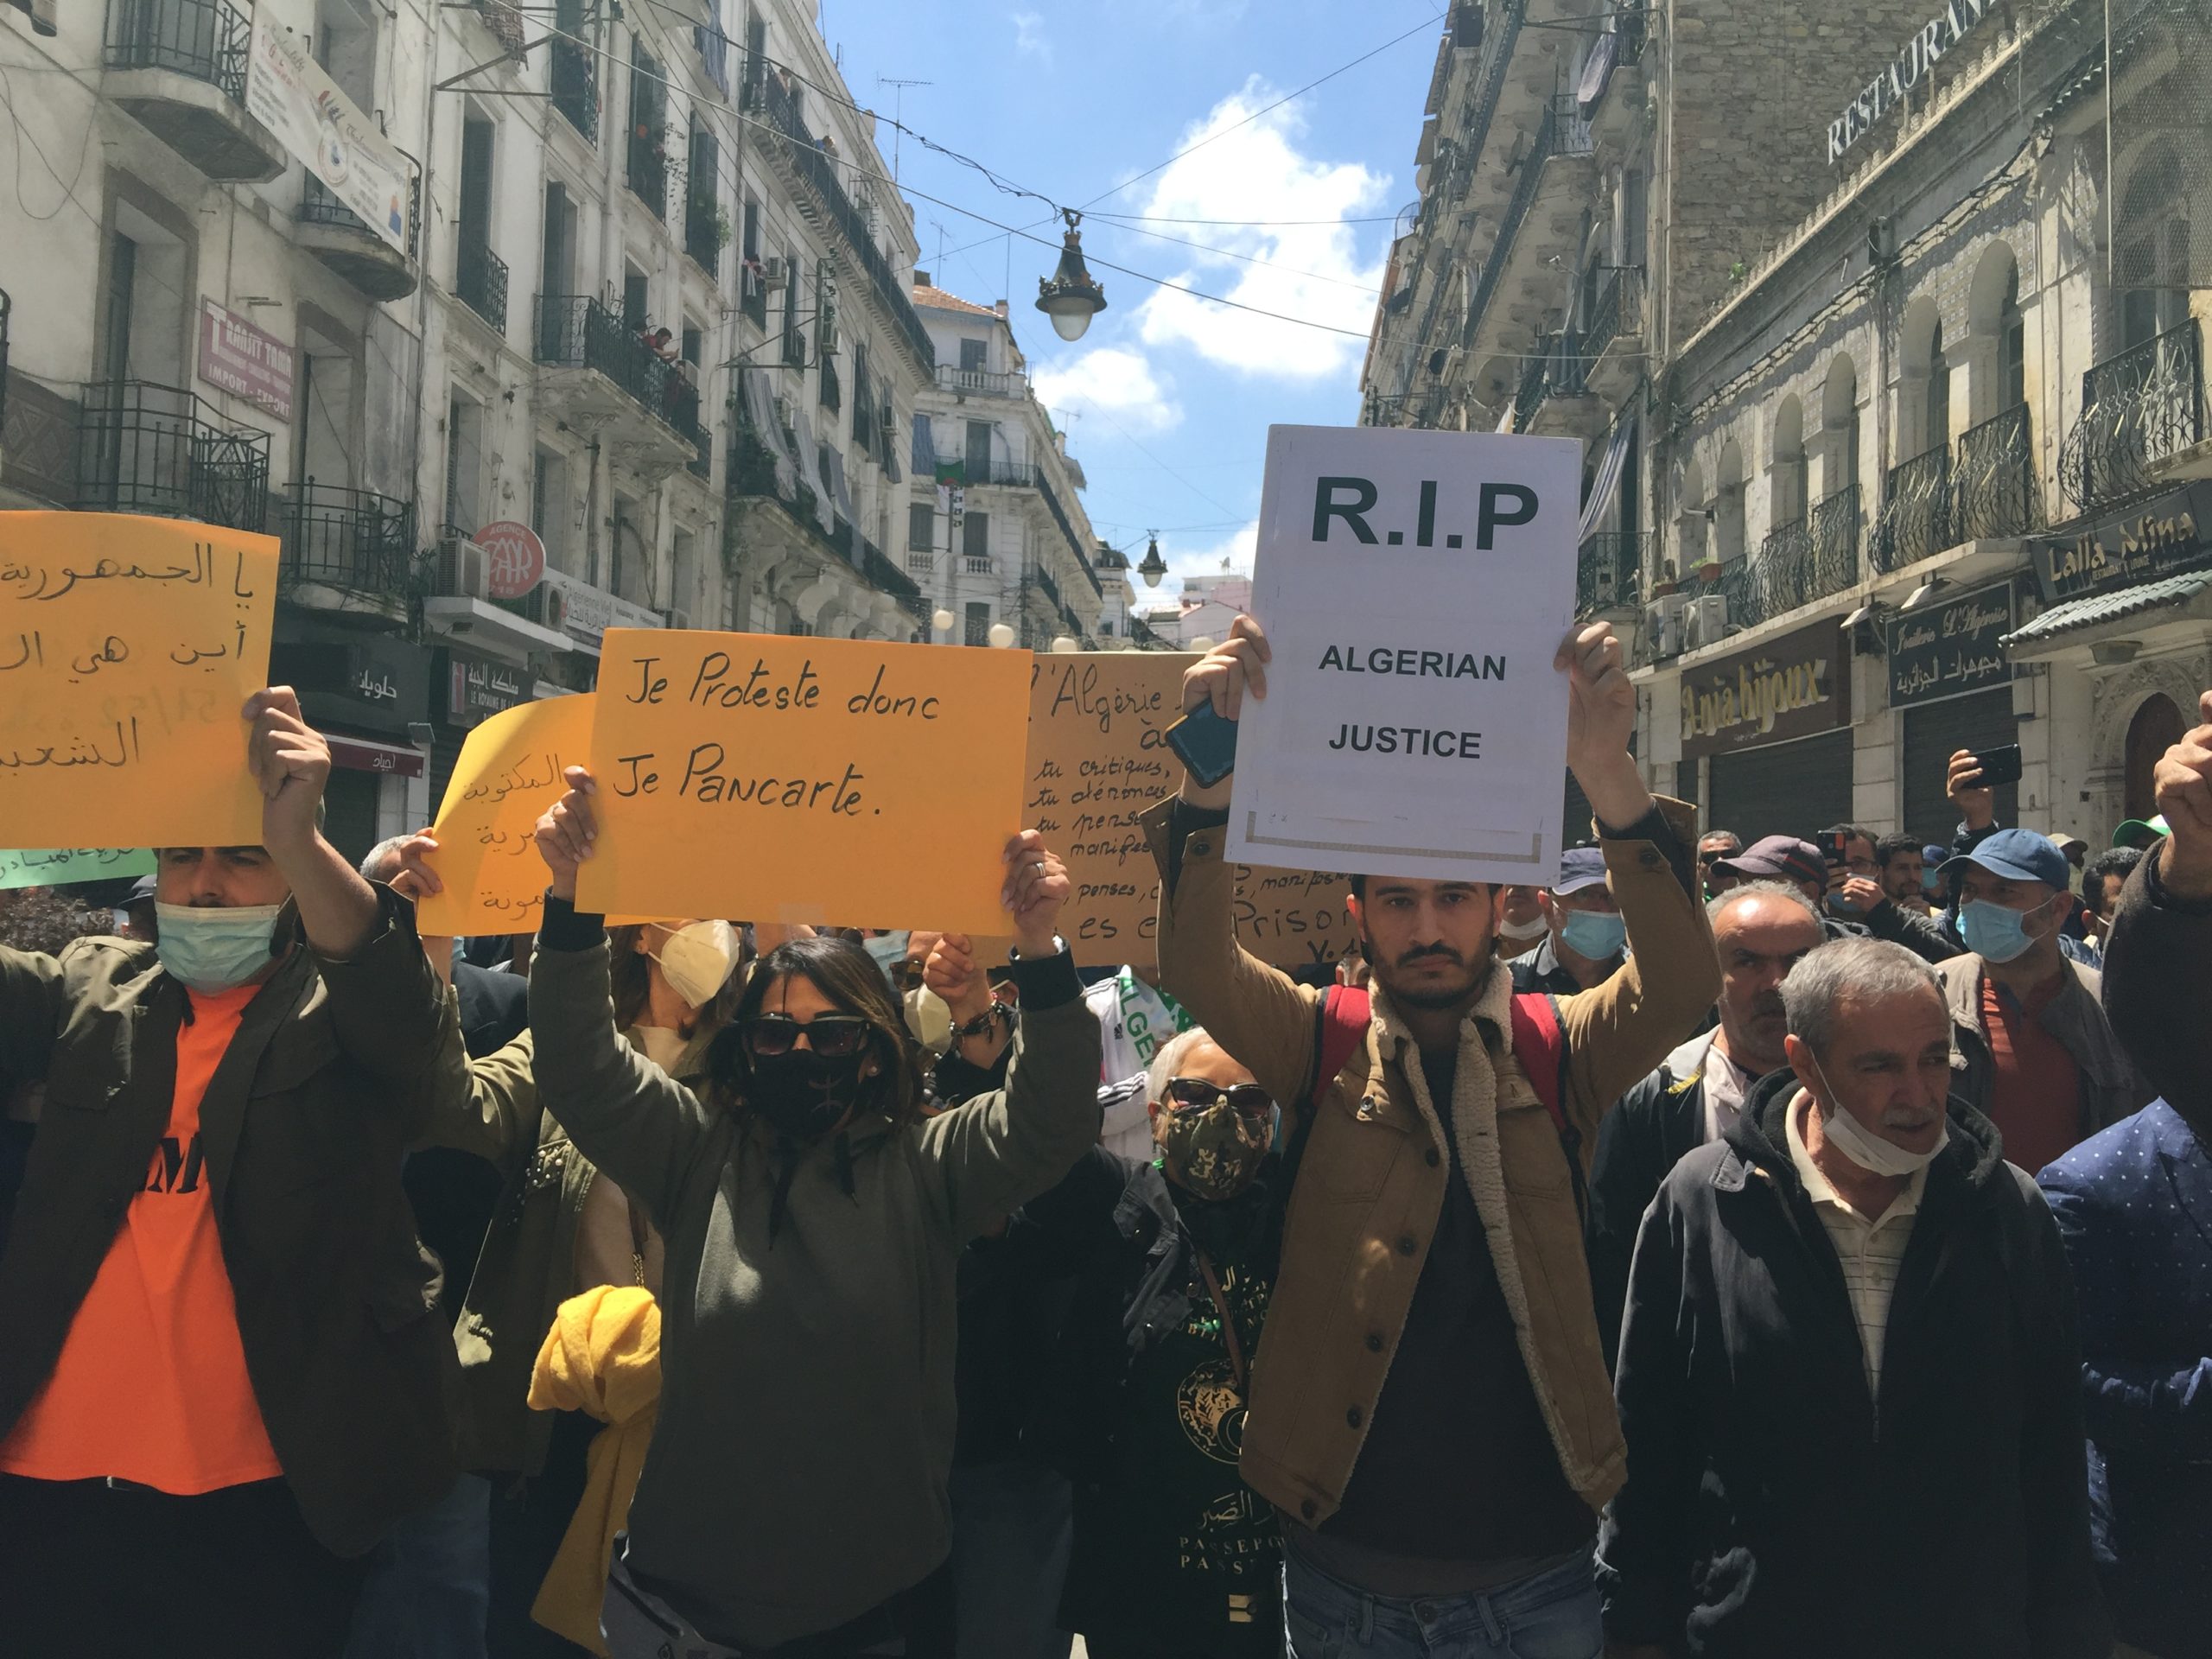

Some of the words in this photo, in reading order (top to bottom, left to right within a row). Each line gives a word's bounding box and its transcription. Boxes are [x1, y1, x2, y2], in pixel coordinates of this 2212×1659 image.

[1827, 0, 1997, 166] RESTAURAN
[208, 363, 247, 395] IMPORT
[257, 388, 290, 417] EXPORT
[489, 524, 526, 540] AGENCE
[1312, 476, 1539, 550] R.I.P
[2048, 531, 2106, 582] Lalla
[2119, 512, 2195, 559] Mina
[0, 542, 212, 601] الجمهورية
[234, 551, 253, 610] يا
[68, 635, 129, 683] هي
[170, 620, 246, 672] أين
[1318, 645, 1506, 681] ALGERIAN
[626, 657, 669, 705] Je
[689, 652, 821, 709] Proteste
[848, 664, 940, 720] donc
[1328, 723, 1482, 760] JUSTICE
[613, 753, 659, 798] Je
[1033, 758, 1064, 781] tu
[1028, 786, 1060, 808] tu
[1034, 817, 1061, 833] tu
[1079, 917, 1118, 939] es
